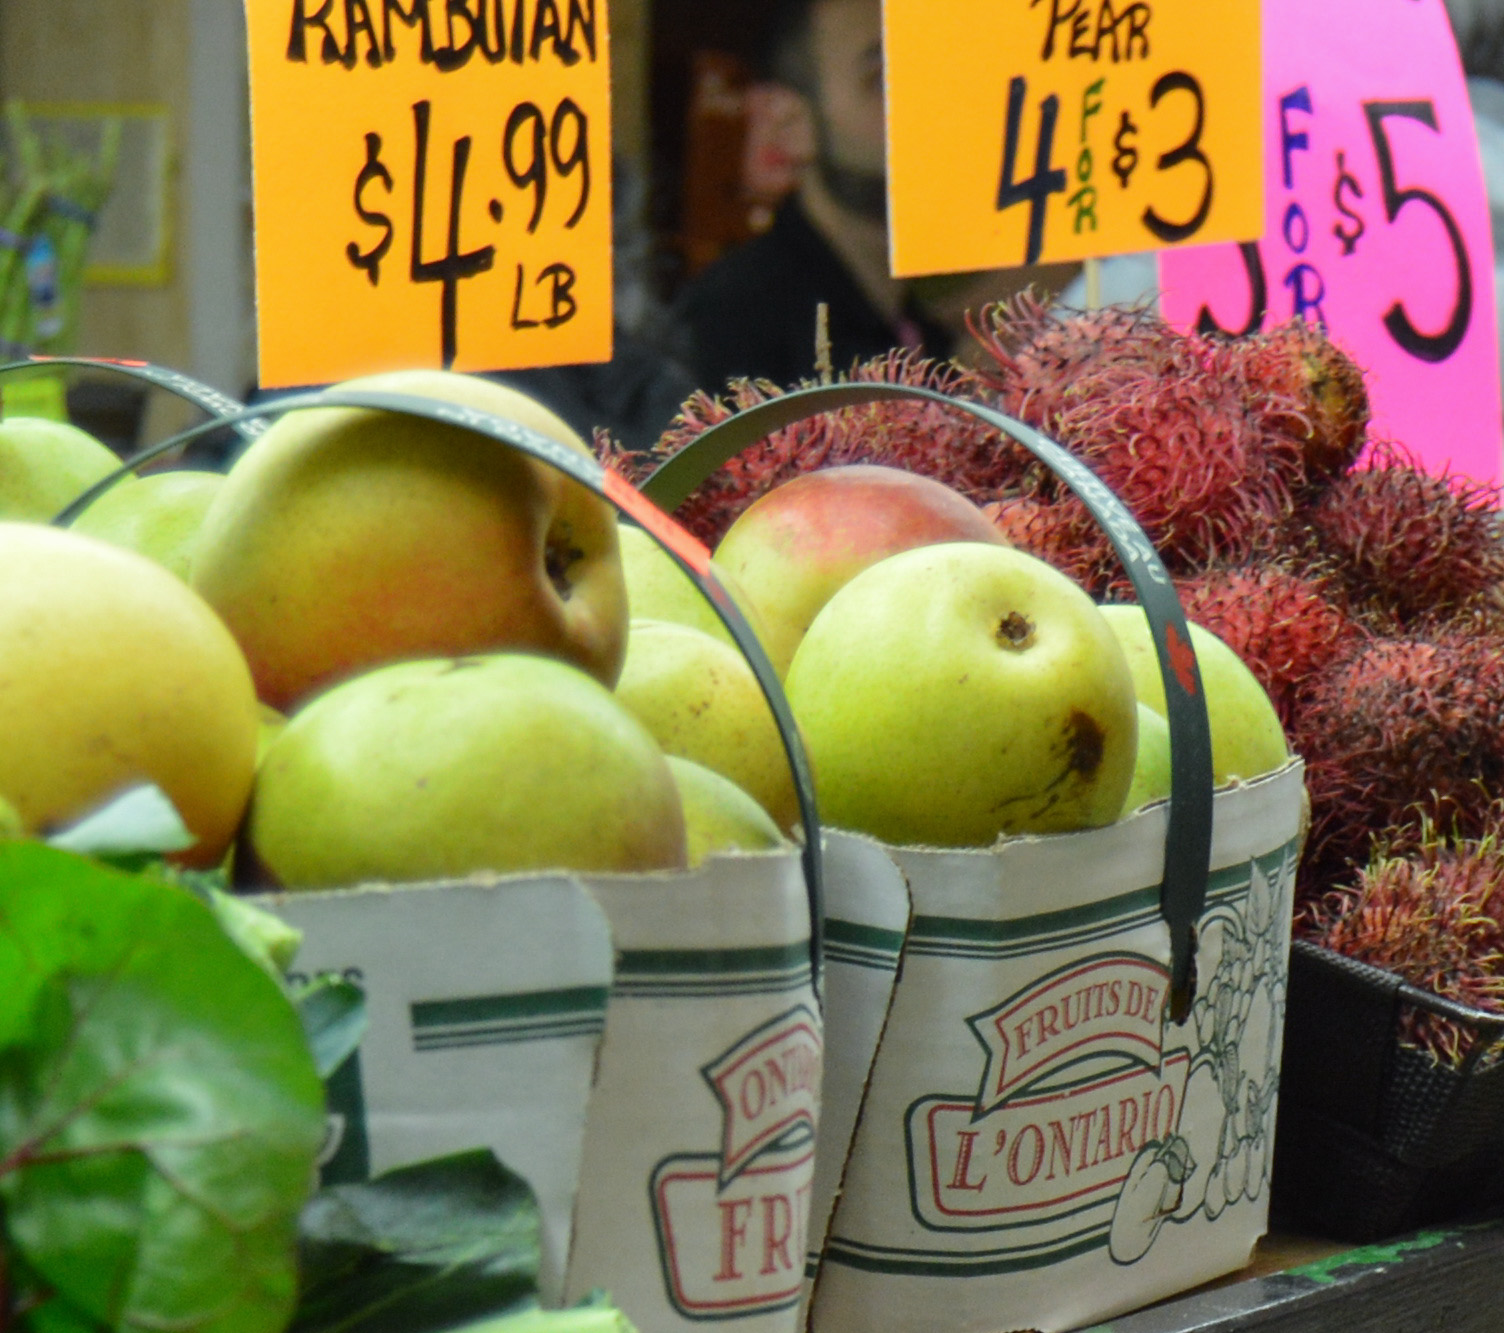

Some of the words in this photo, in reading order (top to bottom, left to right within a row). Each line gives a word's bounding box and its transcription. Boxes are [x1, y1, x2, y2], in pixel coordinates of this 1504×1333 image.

[1030, 0, 1151, 63] PEAR
[996, 75, 1067, 264] 4
[1067, 77, 1105, 233] FOR
[1280, 86, 1328, 338] FOR
[511, 262, 577, 330] LB
[1013, 980, 1123, 1061] FRUITS
[1123, 980, 1160, 1024] DE
[946, 1084, 1175, 1193] L'ONTARIO
